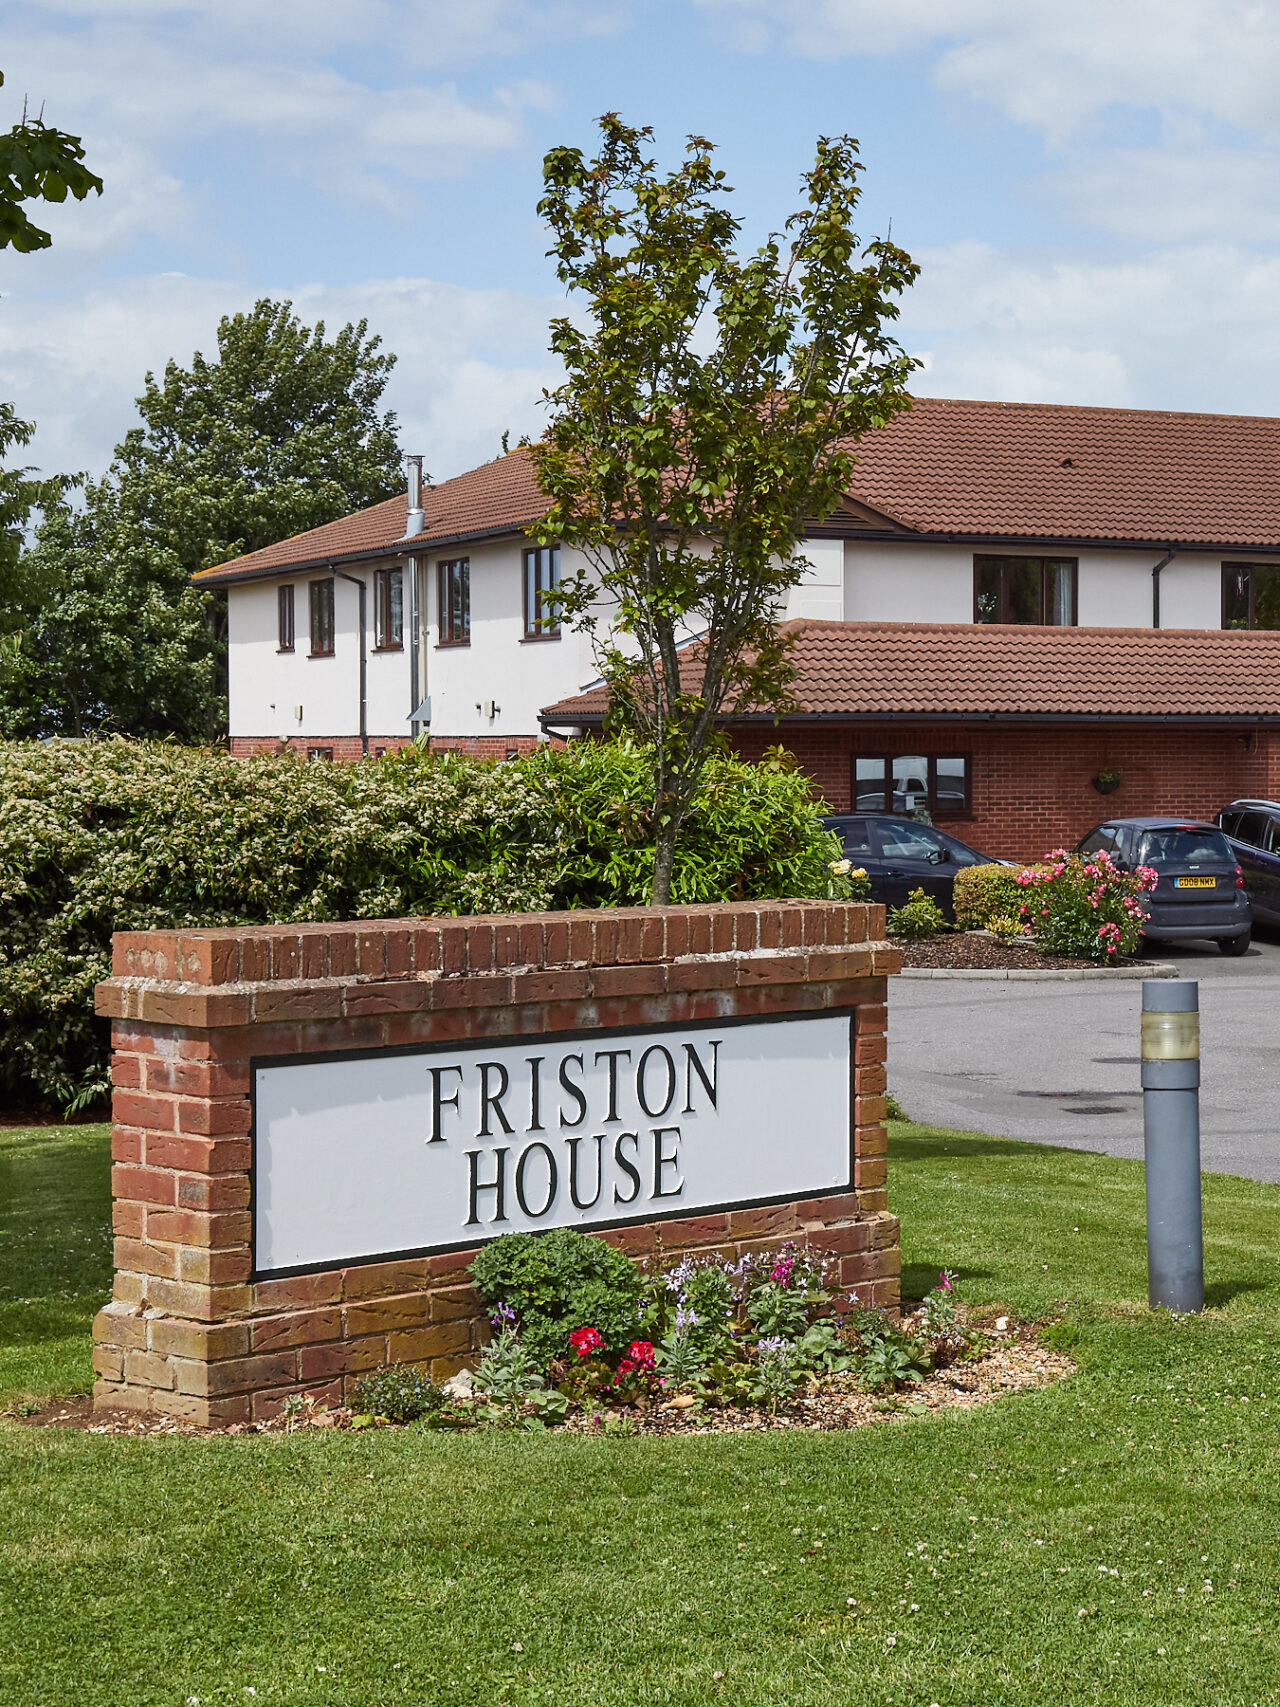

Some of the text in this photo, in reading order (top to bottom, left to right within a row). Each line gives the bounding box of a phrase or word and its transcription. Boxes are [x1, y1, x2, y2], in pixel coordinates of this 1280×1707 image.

[1199, 877, 1214, 886] NMX
[425, 1040, 723, 1144] FRISTON
[463, 1126, 685, 1226] HOUSE
